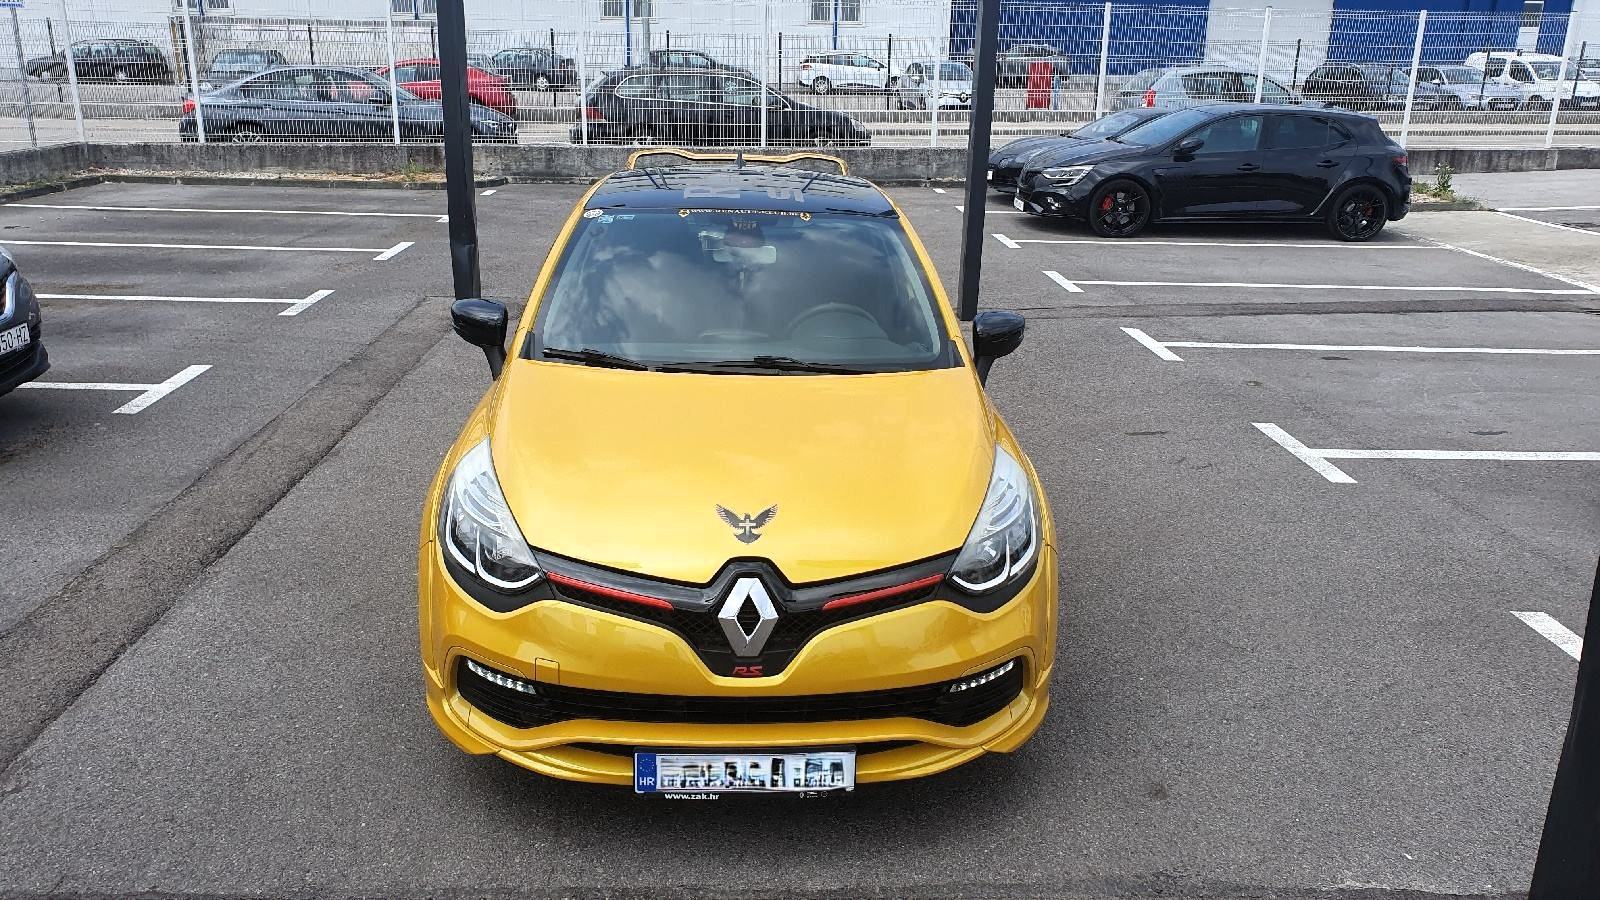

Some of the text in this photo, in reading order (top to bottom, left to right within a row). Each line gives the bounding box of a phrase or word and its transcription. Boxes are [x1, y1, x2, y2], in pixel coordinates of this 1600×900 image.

[0, 325, 29, 352] 50-HZ
[732, 665, 763, 676] RS
[639, 776, 655, 786] HR
[664, 793, 720, 801] www.zak.hr
